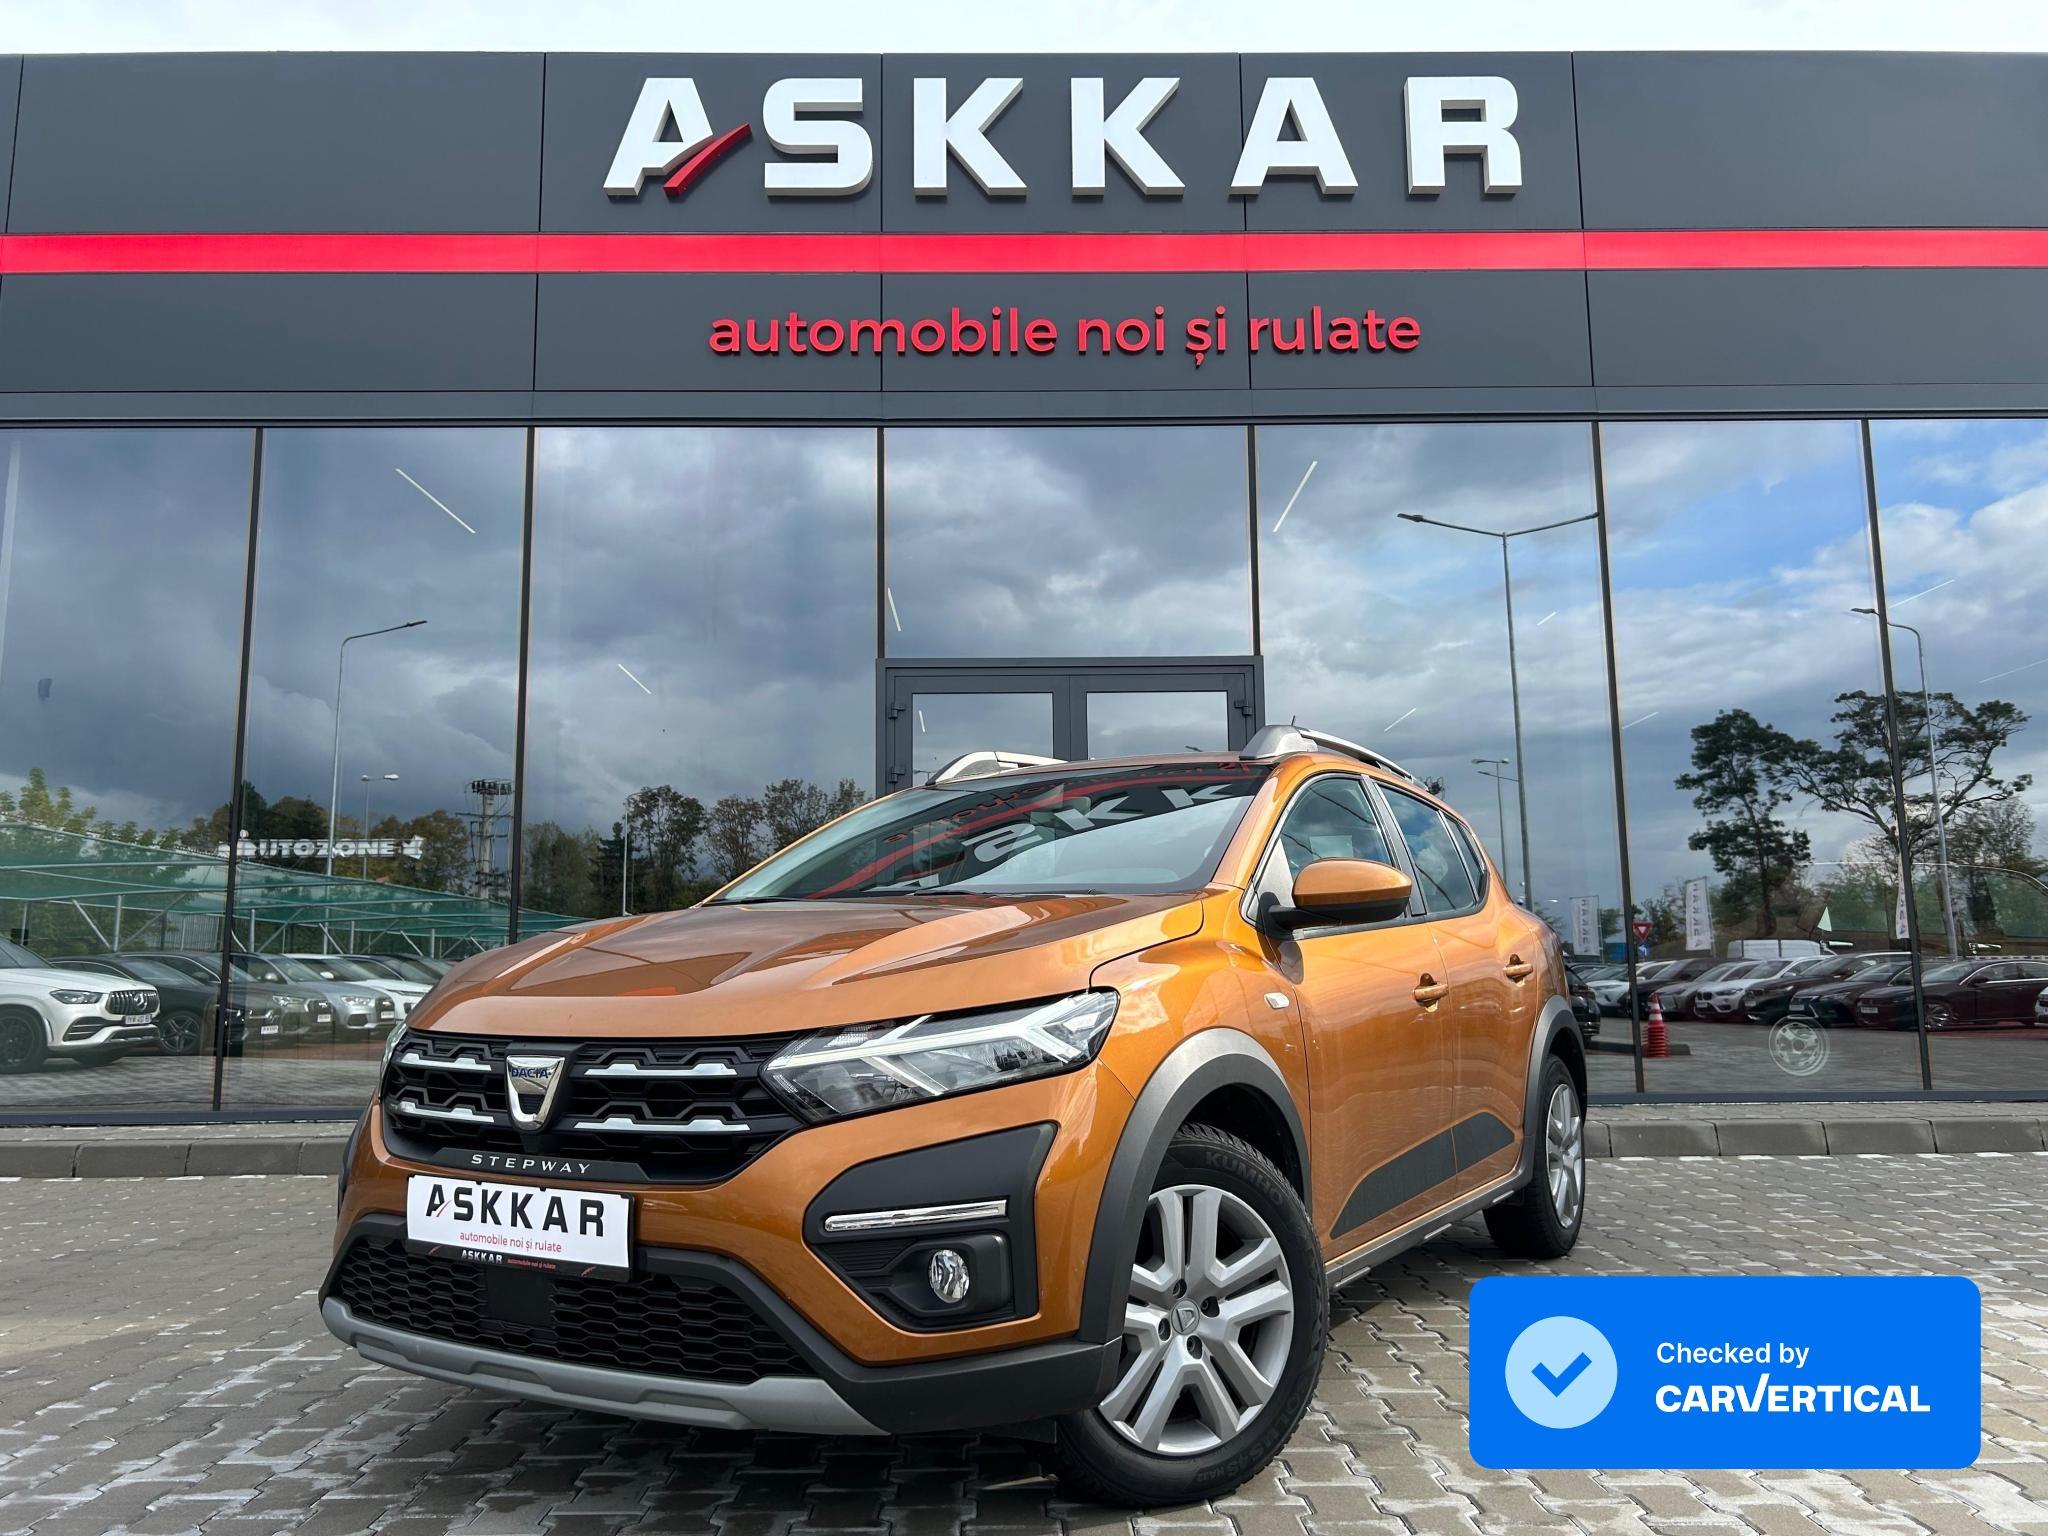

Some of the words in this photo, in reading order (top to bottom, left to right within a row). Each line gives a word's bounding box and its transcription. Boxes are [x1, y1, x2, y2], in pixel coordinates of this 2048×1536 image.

[603, 76, 1522, 197] ASKKAR
[708, 307, 1059, 354] automobile
[1078, 305, 1166, 353] noi
[1185, 305, 1226, 368] și
[1248, 305, 1422, 352] rulate
[511, 1066, 549, 1079] DACIA
[471, 1154, 591, 1174] STEPWAY
[1206, 1151, 1283, 1205] KUMHO
[425, 1183, 605, 1238] ASKKAR
[459, 1230, 508, 1247] automobile
[509, 1236, 524, 1249] noi
[461, 1249, 503, 1265] ASKKAR
